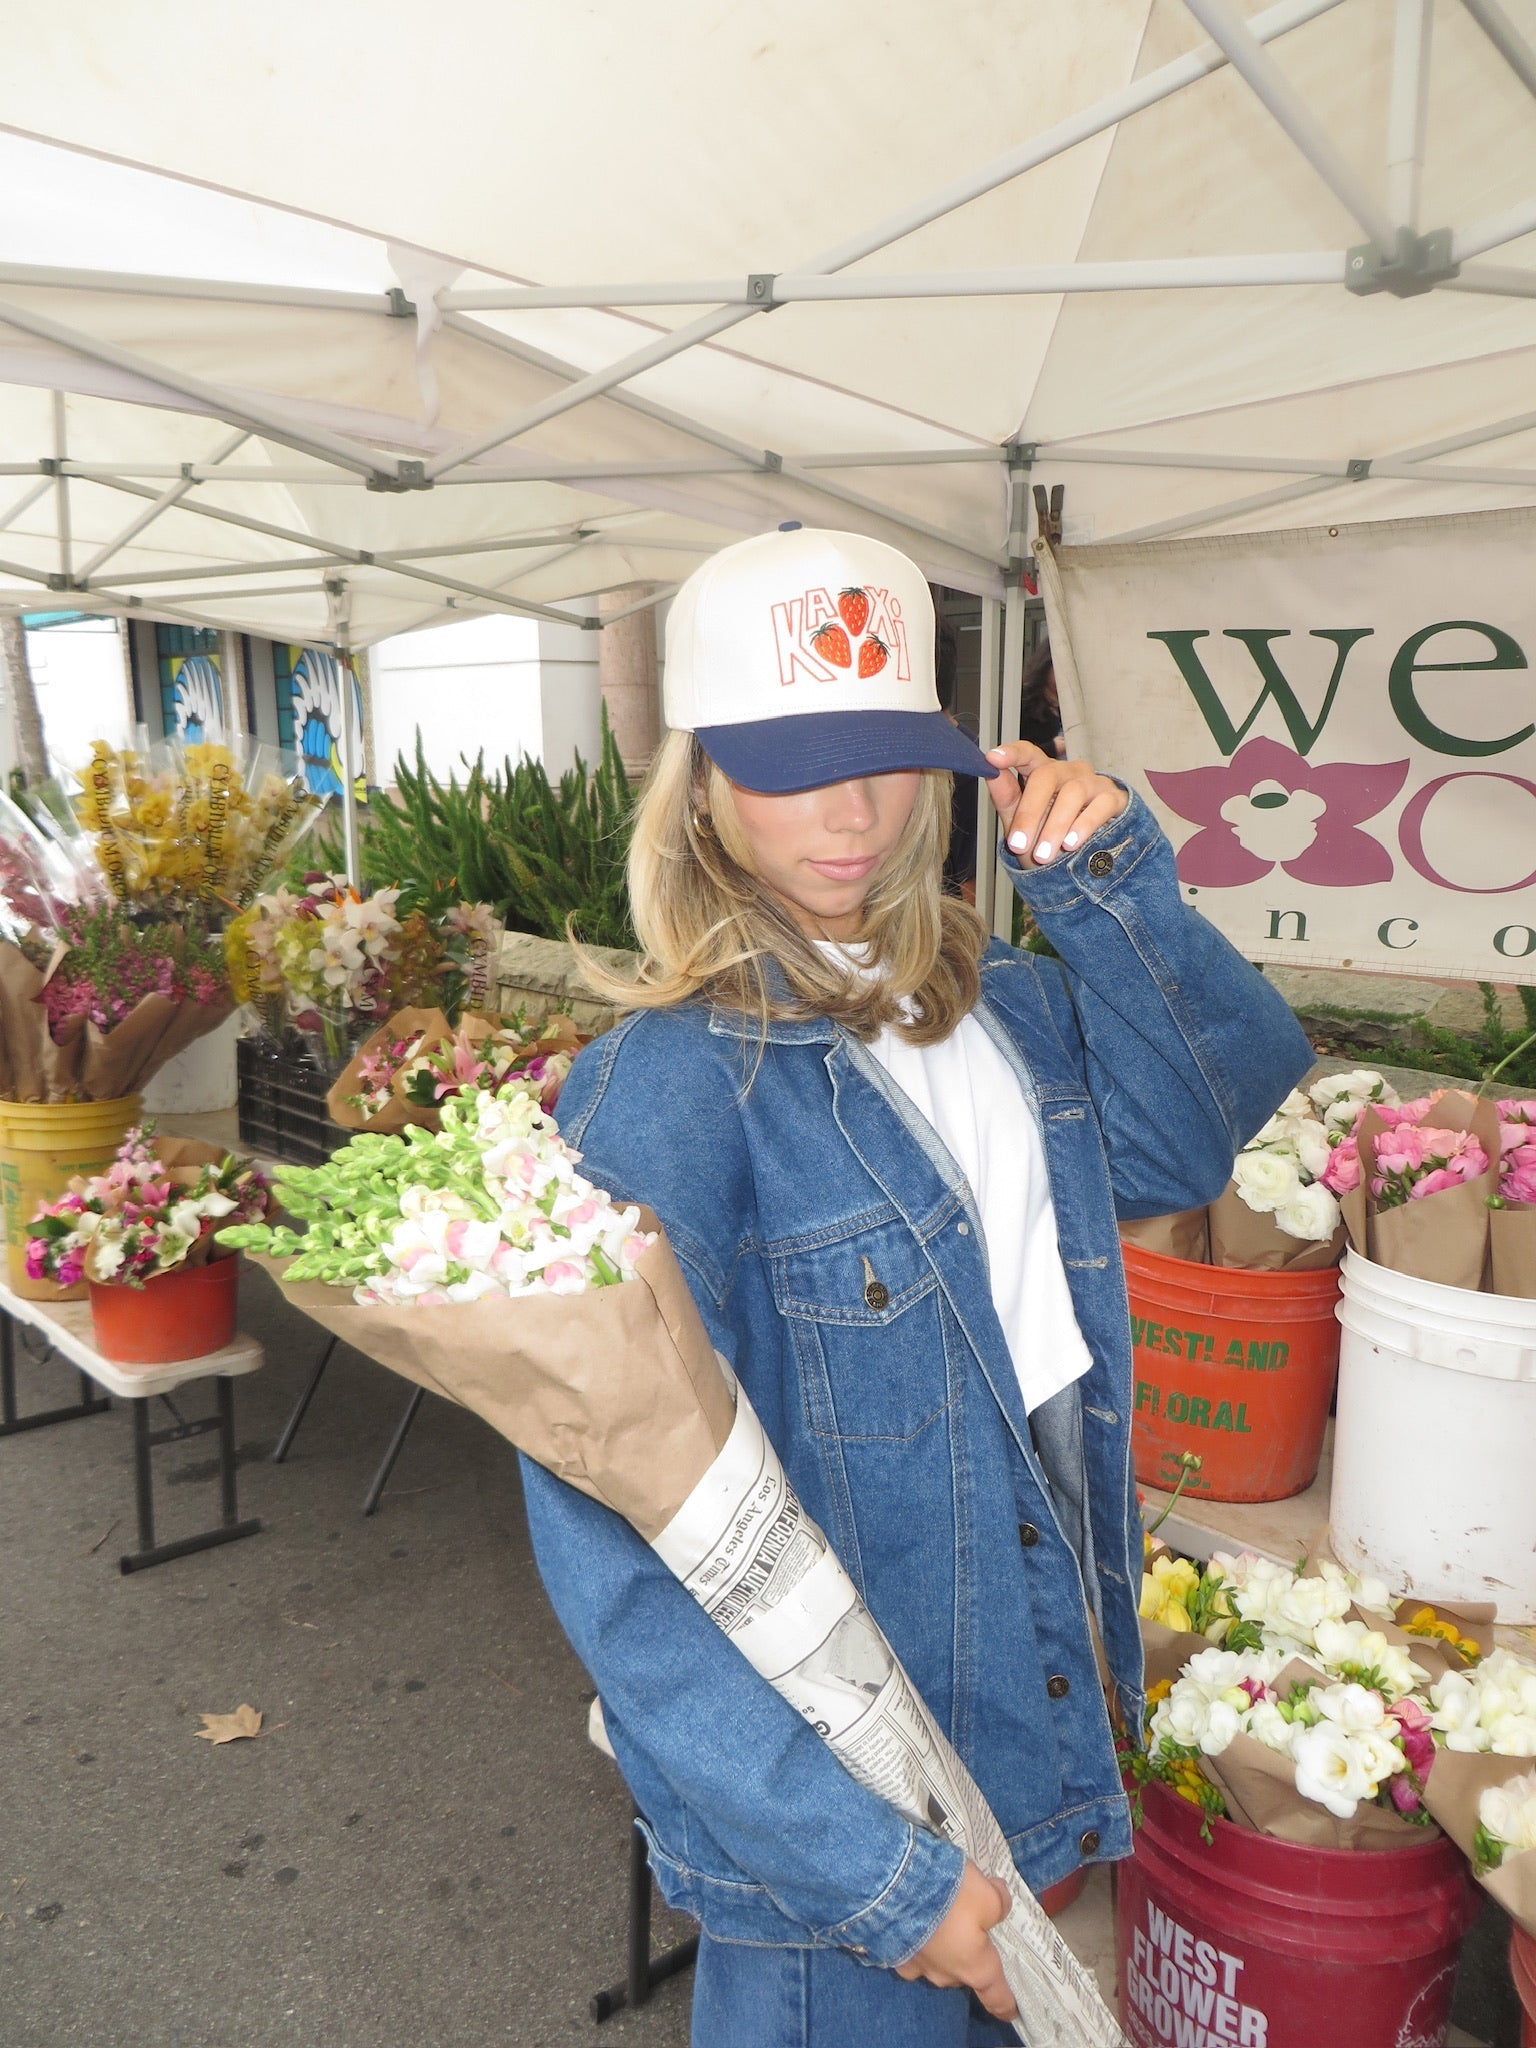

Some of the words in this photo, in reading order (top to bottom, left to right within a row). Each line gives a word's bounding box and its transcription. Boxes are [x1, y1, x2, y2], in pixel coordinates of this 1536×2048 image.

[1188, 887, 1536, 957] nco
[1134, 1380, 1252, 1433] FLORAL
[758, 1475, 777, 1502] Los
[725, 1500, 762, 1556] Angeles
[756, 1486, 799, 1567] CALIFORNIA
[698, 1555, 731, 1587] Times
[1147, 1898, 1244, 1998] WEST
[1127, 1957, 1252, 2048] GROW
[1134, 1925, 1268, 2048] FLOWER
